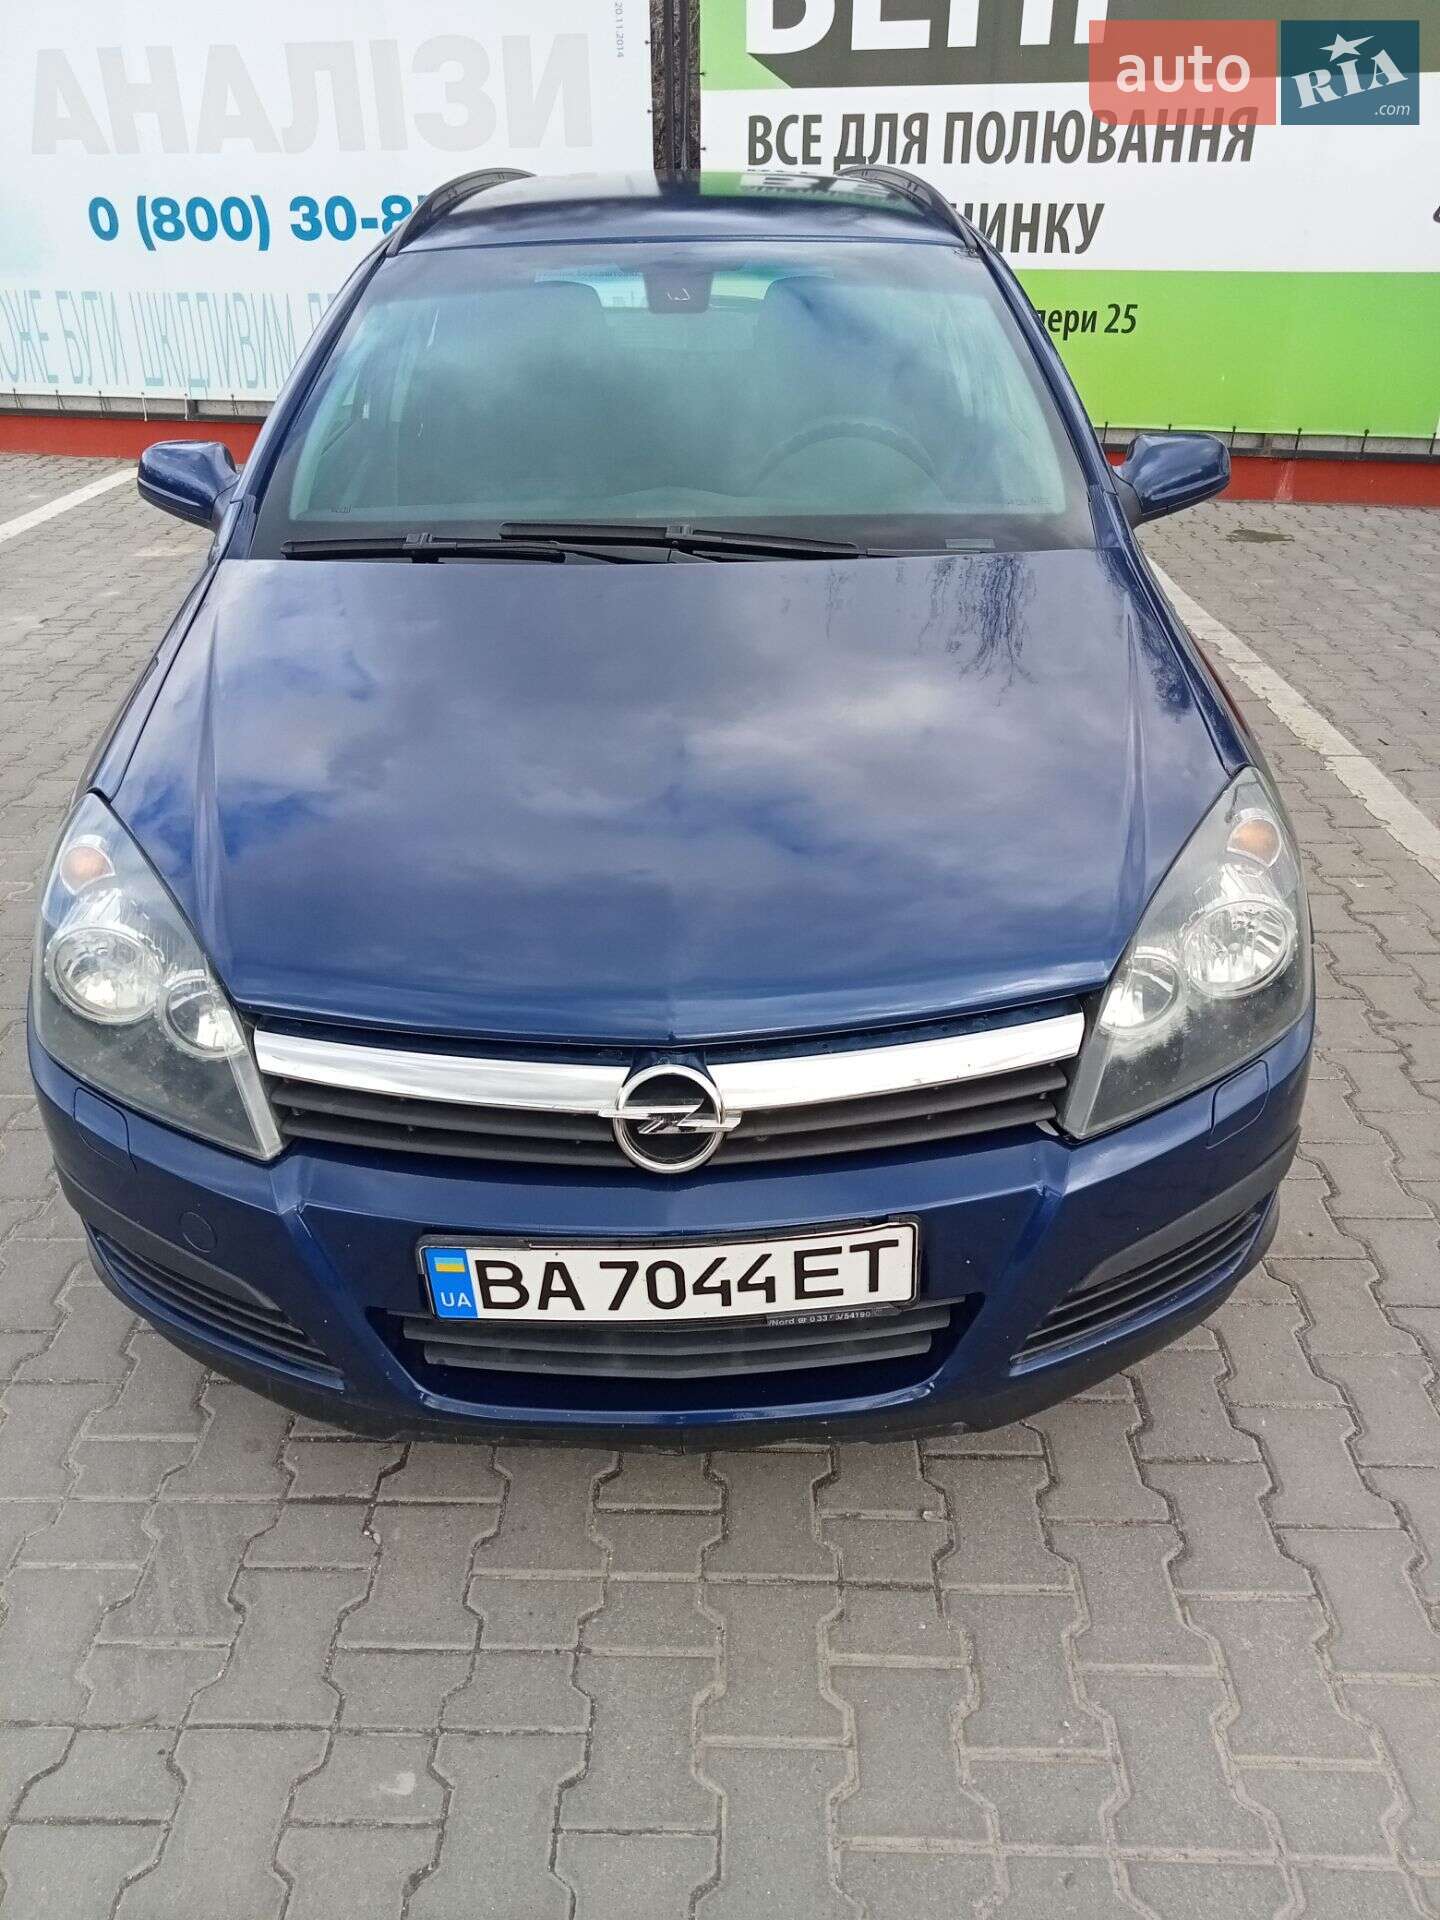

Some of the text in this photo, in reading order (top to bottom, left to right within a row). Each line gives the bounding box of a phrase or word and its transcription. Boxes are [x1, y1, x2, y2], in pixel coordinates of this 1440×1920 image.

[31, 33, 593, 155] АНАЛІЗИ
[747, 106, 1259, 174] ВСЕ ДЛЯ ПОЛЮВАННЯ
[88, 194, 426, 252] 0 (800) 30-8
[1104, 303, 1139, 334] 25
[440, 1291, 472, 1309] UA
[474, 1238, 900, 1312] BA 7044 ET
